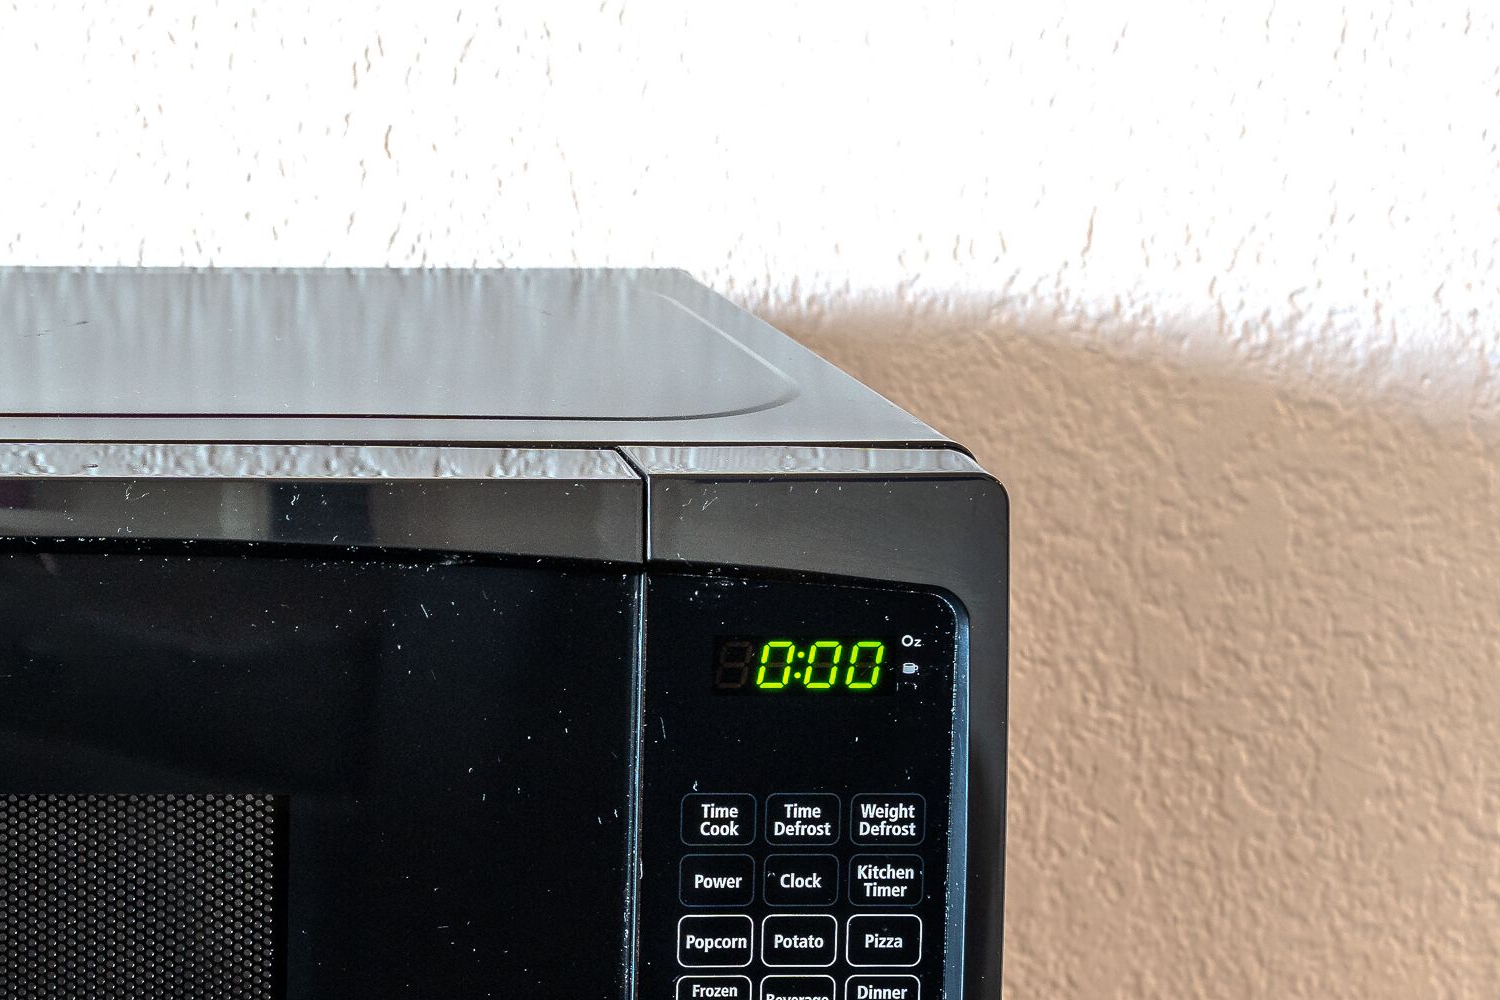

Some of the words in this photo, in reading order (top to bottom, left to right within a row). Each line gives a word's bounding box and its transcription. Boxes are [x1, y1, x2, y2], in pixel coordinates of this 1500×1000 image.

[901, 634, 922, 647] Oz
[701, 803, 739, 819] Time
[783, 803, 822, 819] Time
[860, 802, 916, 823] Weight
[700, 820, 740, 836] Cook
[773, 820, 832, 836] Defrost
[859, 820, 917, 837] Defrost
[857, 863, 915, 880] Kitchen
[694, 874, 743, 889] Power
[779, 872, 822, 889] Clock
[863, 881, 908, 898] Timer
[685, 934, 748, 953] Popcorn
[774, 934, 824, 949] Potato
[864, 933, 903, 949] Pizza
[692, 984, 738, 998] Frozen
[857, 984, 908, 1000] Dinner
